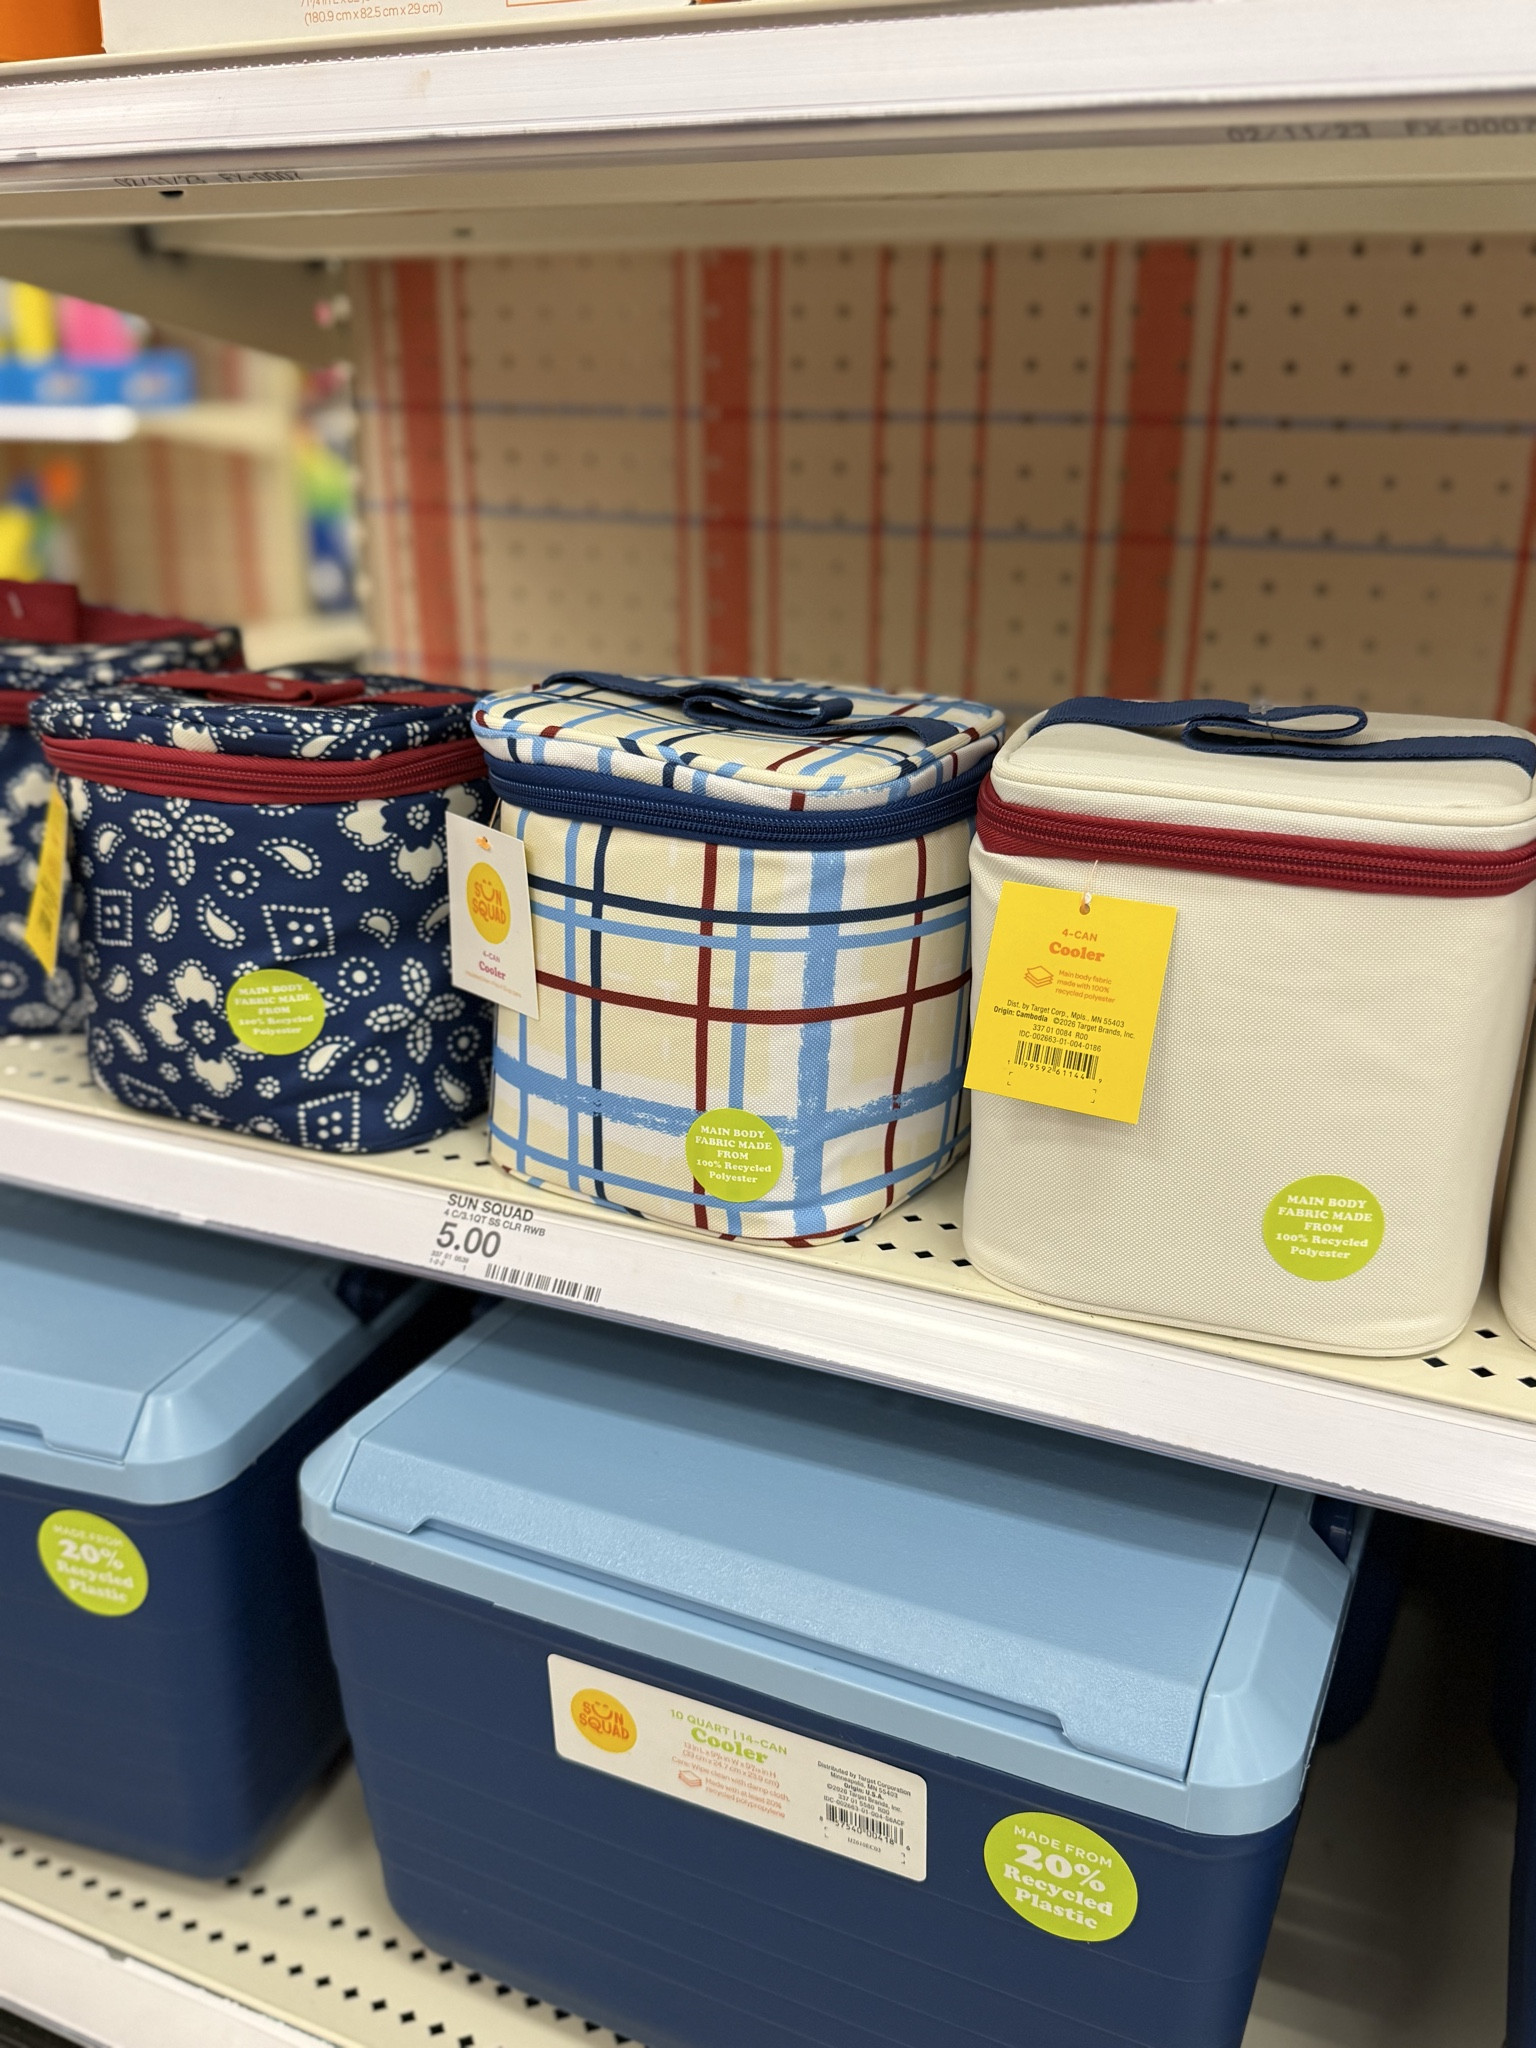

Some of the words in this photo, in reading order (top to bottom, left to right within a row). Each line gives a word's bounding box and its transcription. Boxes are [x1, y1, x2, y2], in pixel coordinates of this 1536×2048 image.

[304, 10, 334, 26] (180.9
[336, 11, 351, 21] cm
[353, 10, 359, 19] x
[360, 6, 381, 19] 82.5
[382, 6, 398, 17] cm
[400, 6, 406, 15] x
[408, 3, 420, 15] 29
[422, 1, 443, 15] cm)
[1226, 121, 1371, 142] 02/11/23
[474, 879, 502, 907] SUN
[472, 898, 506, 925] SQUAD
[1062, 928, 1098, 942] 4-CAN
[1049, 941, 1105, 962] Cooler
[478, 960, 506, 980] Cooler
[1059, 970, 1074, 978] Main
[1075, 973, 1092, 982] body
[1092, 976, 1112, 985] fabric
[238, 986, 269, 995] MAIN
[272, 984, 303, 993] BODY
[1055, 988, 1083, 998] recycled
[1084, 993, 1116, 1003] polyester
[1057, 979, 1076, 987] made
[1077, 982, 1090, 990] with
[1092, 985, 1110, 993] 100%
[234, 996, 275, 1006] FABRIC
[278, 993, 311, 1003] MADE
[258, 1006, 290, 1015] FROM
[267, 1015, 314, 1025] Recycled
[1007, 999, 1020, 1008] Dist.
[1022, 1002, 1030, 1011] by
[1031, 1003, 1050, 1014] Target
[1091, 1015, 1103, 1024] MN
[1103, 1018, 1125, 1028] 55403
[252, 1027, 302, 1036] Polyester
[993, 1005, 1015, 1016] Origin:
[1016, 1010, 1048, 1022] Cambodia
[1077, 1021, 1097, 1032] Target
[1098, 1026, 1122, 1038] Brands,
[1124, 1031, 1136, 1039] Inc.
[1032, 1023, 1045, 1032] 337
[1046, 1026, 1054, 1034] 01
[1055, 1028, 1072, 1037] 0084
[1023, 1061, 1052, 1074] 99592
[1055, 1069, 1085, 1081] 61144
[700, 1125, 730, 1136] MAIN
[733, 1129, 765, 1139] BODY
[695, 1136, 735, 1148] FABRIC
[738, 1141, 772, 1150] MADE
[717, 1150, 749, 1160] FROM
[696, 1159, 722, 1168] 100%
[725, 1161, 772, 1173] Recycled
[709, 1171, 758, 1183] Polyester
[447, 1193, 479, 1211] SUN
[481, 1200, 534, 1222] SQUAD
[1287, 1195, 1325, 1206] MAIN
[1328, 1198, 1367, 1209] BODY
[444, 1209, 450, 1217] 4
[451, 1210, 487, 1224] C/3.1QT
[488, 1217, 501, 1227] SS
[502, 1220, 522, 1232] CLR
[523, 1224, 546, 1237] RWB
[1278, 1206, 1329, 1219] FABRIC
[1332, 1211, 1373, 1222] MADE
[1304, 1222, 1344, 1233] FROM
[436, 1221, 502, 1258] 5.00
[1276, 1233, 1309, 1243] 100%
[1312, 1235, 1369, 1248] Recycled
[1290, 1246, 1351, 1259] Polyester
[53, 1524, 86, 1539] MADE
[88, 1531, 124, 1547] FROM
[58, 1538, 125, 1571] 20%
[56, 1559, 135, 1589] Recycled
[68, 1578, 127, 1603] Plastic
[583, 1701, 624, 1725] SUN
[579, 1712, 630, 1740] SQUAD
[670, 1709, 684, 1720] 10
[687, 1715, 730, 1735] QUART
[740, 1732, 787, 1755] 14-CAN
[691, 1727, 768, 1763] Cooler
[817, 1760, 849, 1776] Distributed
[849, 1771, 856, 1780] by
[858, 1774, 876, 1786] Target
[877, 1780, 911, 1796] Corporation
[843, 1782, 865, 1795] Origin:
[849, 1790, 867, 1801] Target
[867, 1783, 878, 1792] MN
[878, 1787, 898, 1799] 55403
[1014, 1824, 1060, 1850] MADE
[1065, 1843, 1112, 1868] FROM
[1014, 1843, 1106, 1892] 20%
[1003, 1863, 1114, 1917] Recycled
[1015, 1886, 1098, 1930] Plastic
